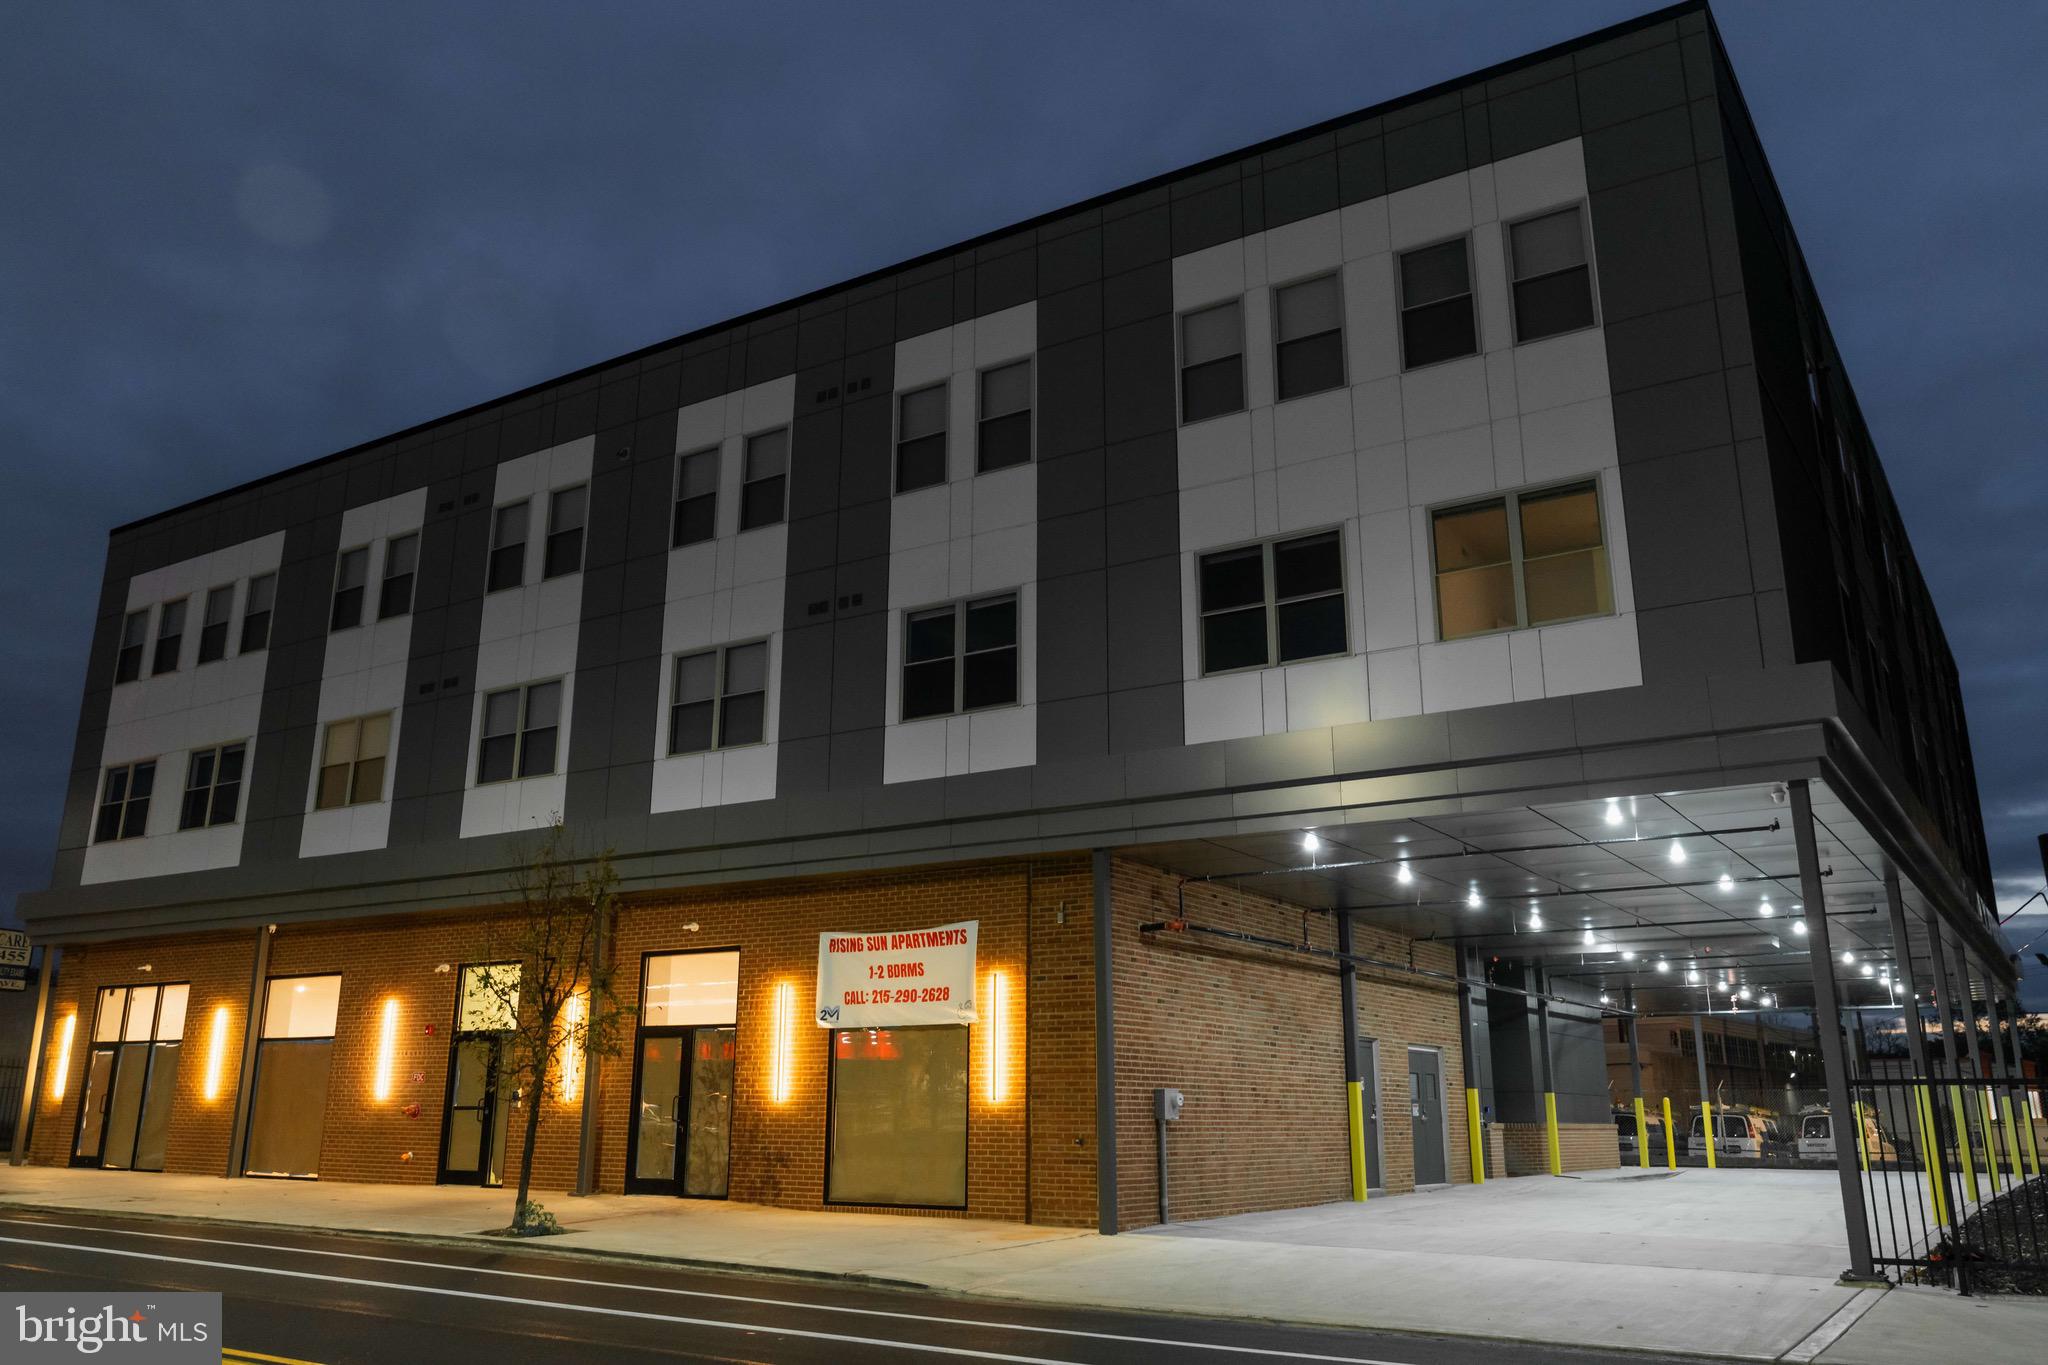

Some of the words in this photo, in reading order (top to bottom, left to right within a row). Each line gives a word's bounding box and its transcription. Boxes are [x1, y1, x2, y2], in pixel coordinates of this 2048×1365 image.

[829, 937, 864, 953] RISING
[867, 935, 888, 951] SUN
[892, 929, 967, 950] APARTMENTS
[869, 965, 884, 979] 1-2
[887, 962, 924, 978] BDRMS
[844, 990, 869, 1005] CALL:
[871, 987, 950, 1004] 215-290-2628
